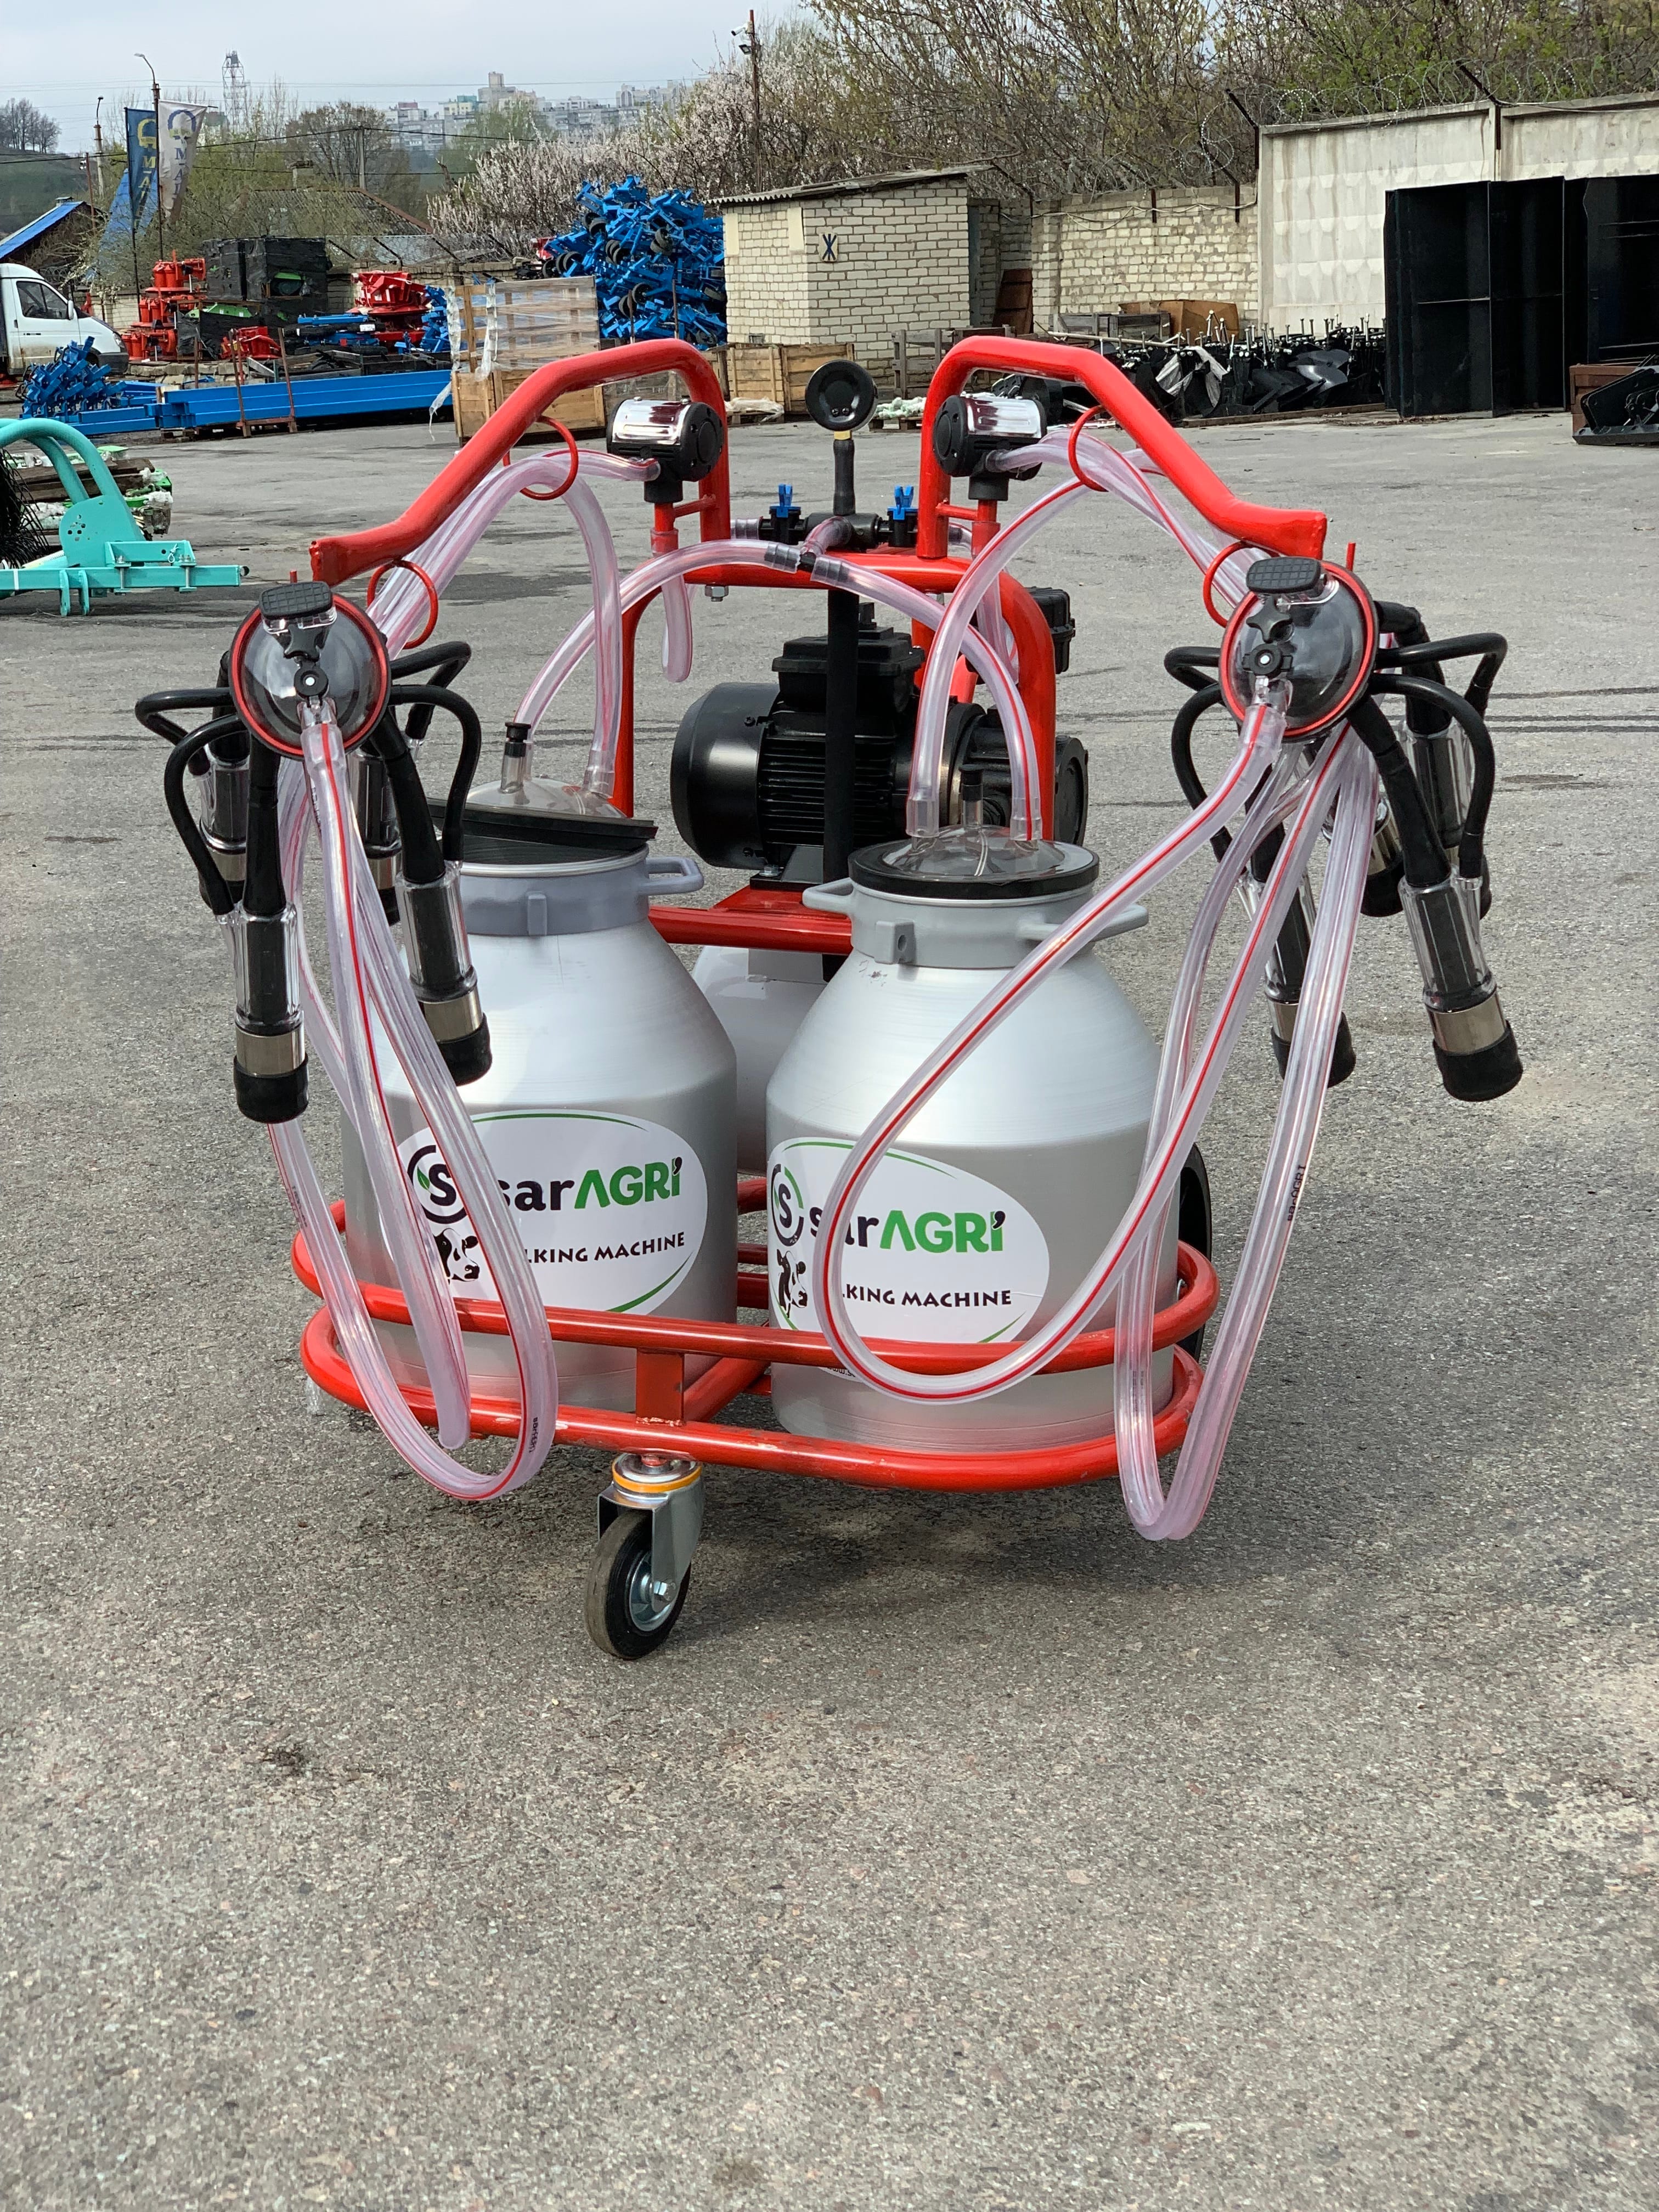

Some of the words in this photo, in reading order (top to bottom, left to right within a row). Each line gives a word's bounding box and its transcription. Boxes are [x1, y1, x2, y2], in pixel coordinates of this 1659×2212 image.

[594, 1232, 685, 1261] MACHINE
[843, 1284, 895, 1305] KING
[901, 1289, 1012, 1307] MACHINE
